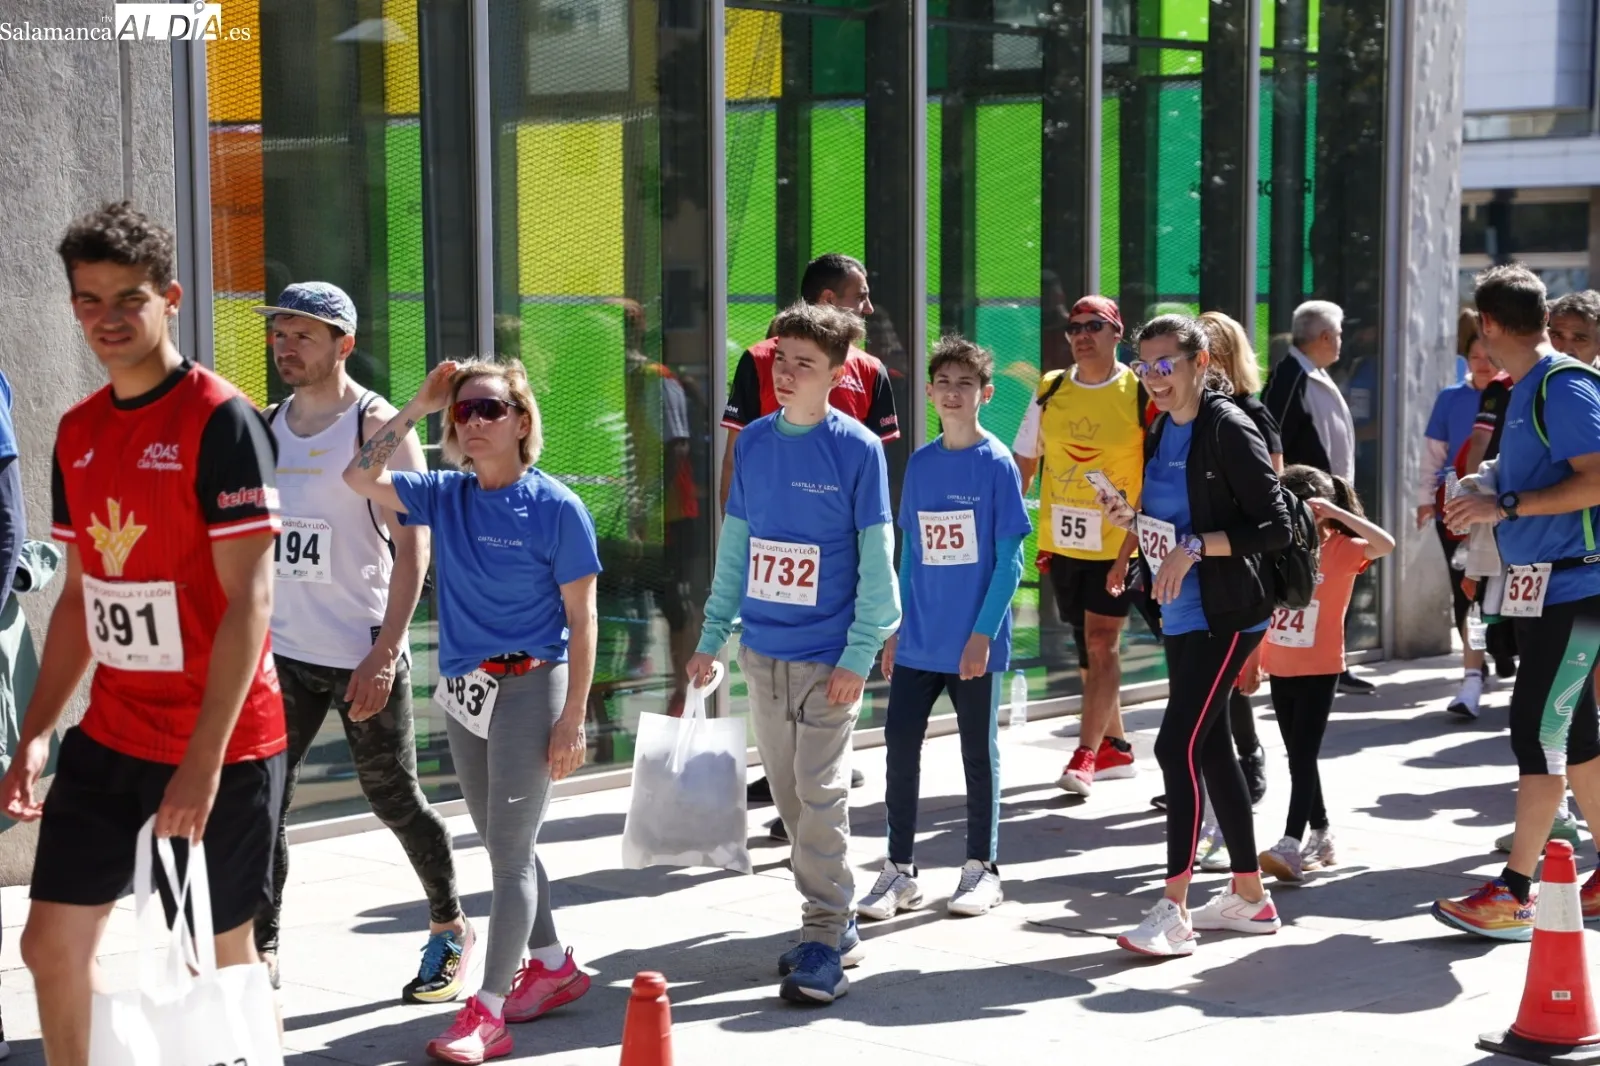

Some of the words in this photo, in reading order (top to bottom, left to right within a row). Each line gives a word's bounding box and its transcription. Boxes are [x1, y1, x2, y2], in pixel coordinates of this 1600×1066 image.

[143, 442, 179, 460] ADAS
[791, 481, 816, 489] CASTILLA
[925, 523, 965, 550] 525
[1061, 515, 1087, 540] 55
[274, 531, 321, 566] 194
[765, 544, 793, 554] CASTILLA
[799, 546, 818, 556] LEÓN
[1141, 529, 1169, 562] 526
[752, 552, 815, 588] 1732
[1509, 575, 1543, 602] 523
[94, 598, 160, 647] 391
